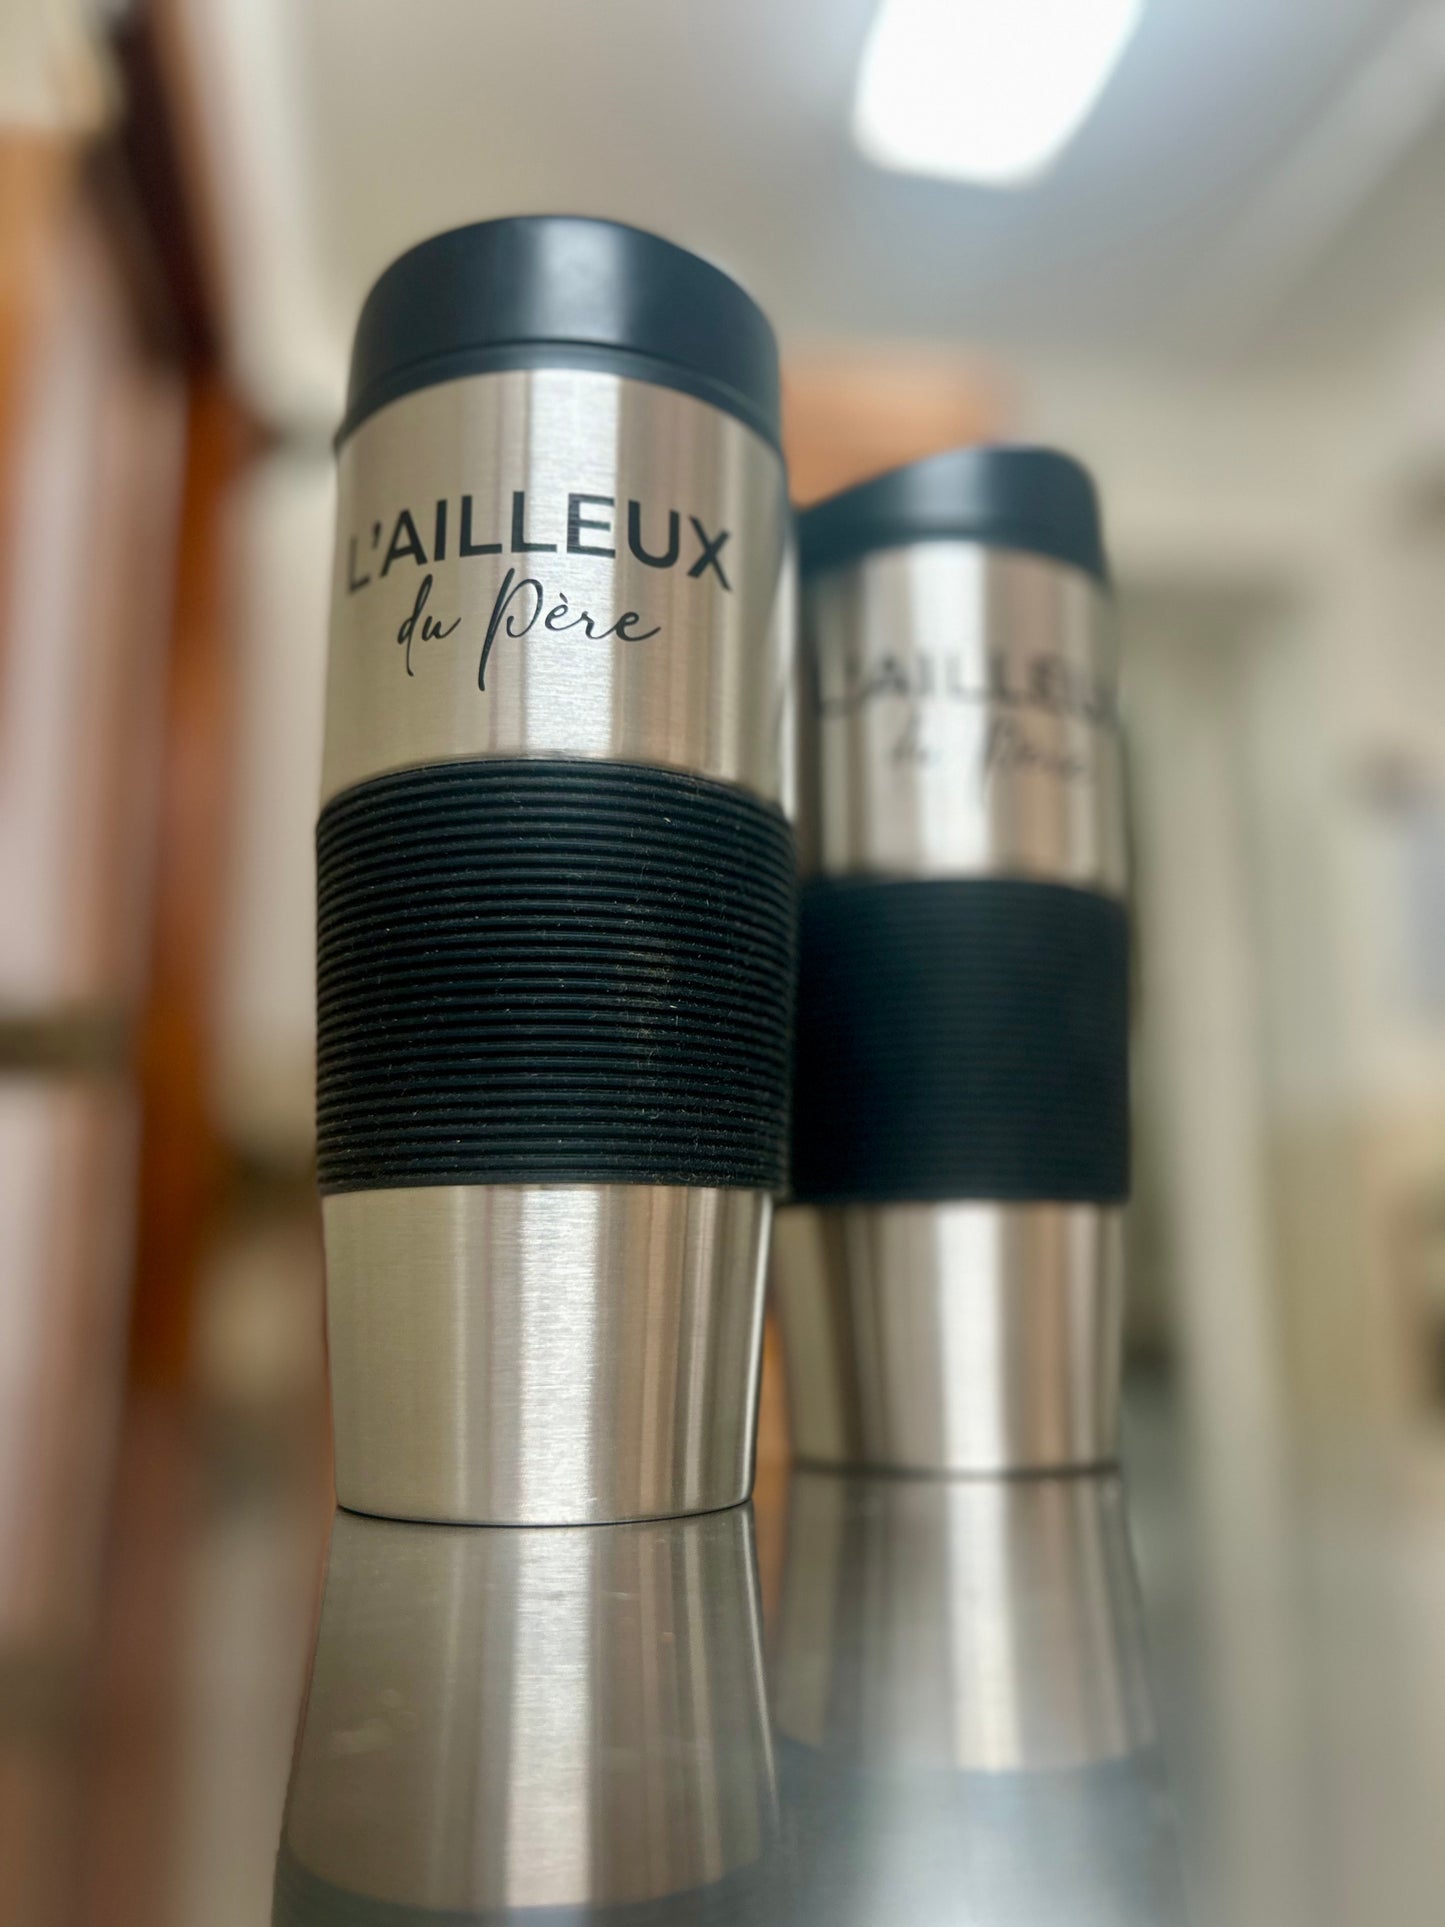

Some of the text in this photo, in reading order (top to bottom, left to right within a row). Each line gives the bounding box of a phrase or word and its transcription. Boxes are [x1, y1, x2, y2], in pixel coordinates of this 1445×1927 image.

[349, 491, 731, 593] L'AILLEUX
[398, 568, 661, 692] du Père
